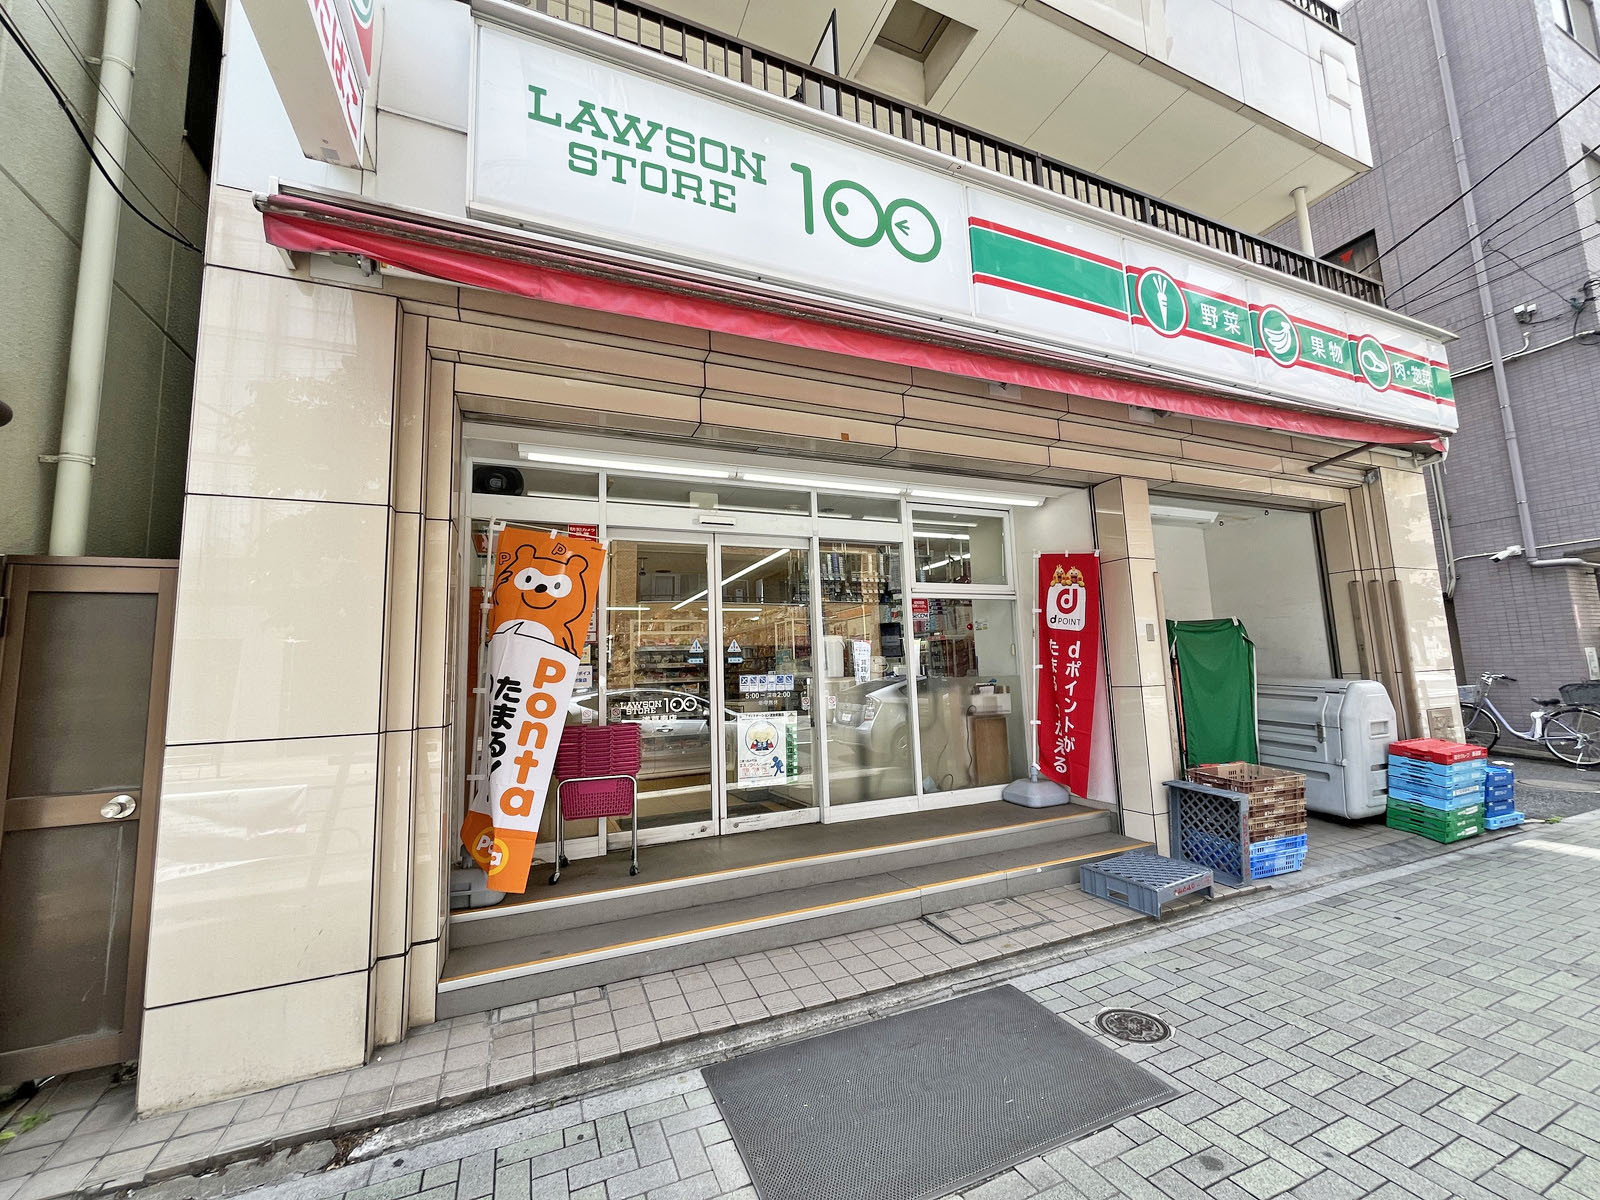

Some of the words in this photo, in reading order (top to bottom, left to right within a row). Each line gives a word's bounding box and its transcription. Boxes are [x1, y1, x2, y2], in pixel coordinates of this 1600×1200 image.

[527, 84, 767, 186] LAWSON
[568, 141, 737, 214] STORE
[790, 162, 942, 263] 100
[1200, 303, 1241, 336] 野菜
[1310, 335, 1344, 365] 果物
[1058, 618, 1081, 626] POINT
[620, 700, 662, 710] LAWSON
[626, 707, 656, 715] STORE
[664, 697, 697, 712] 100
[1064, 640, 1081, 753] dポイントが
[500, 657, 567, 817] Ponta
